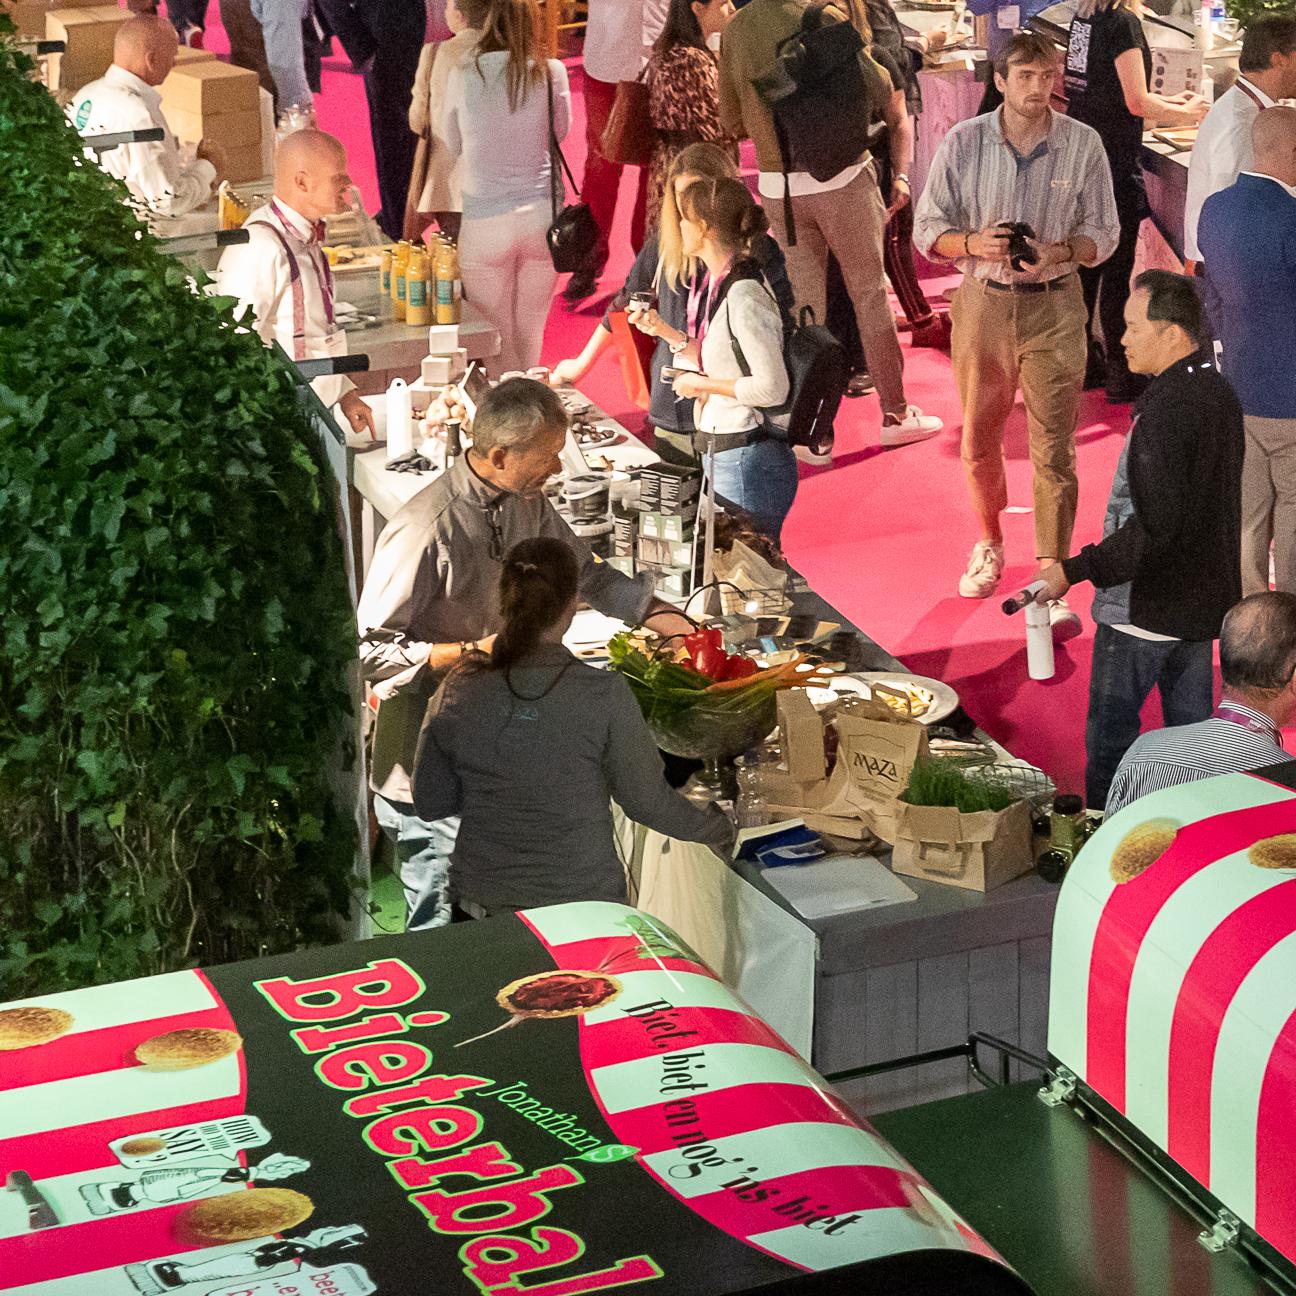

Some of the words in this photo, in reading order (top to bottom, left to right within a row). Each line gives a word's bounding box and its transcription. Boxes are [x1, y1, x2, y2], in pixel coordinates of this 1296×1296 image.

[659, 1050, 709, 1095] biet
[252, 957, 665, 1296] Bieterbal
[662, 1099, 700, 1128] en
[668, 1131, 744, 1180] nog
[771, 1195, 864, 1237] biet
